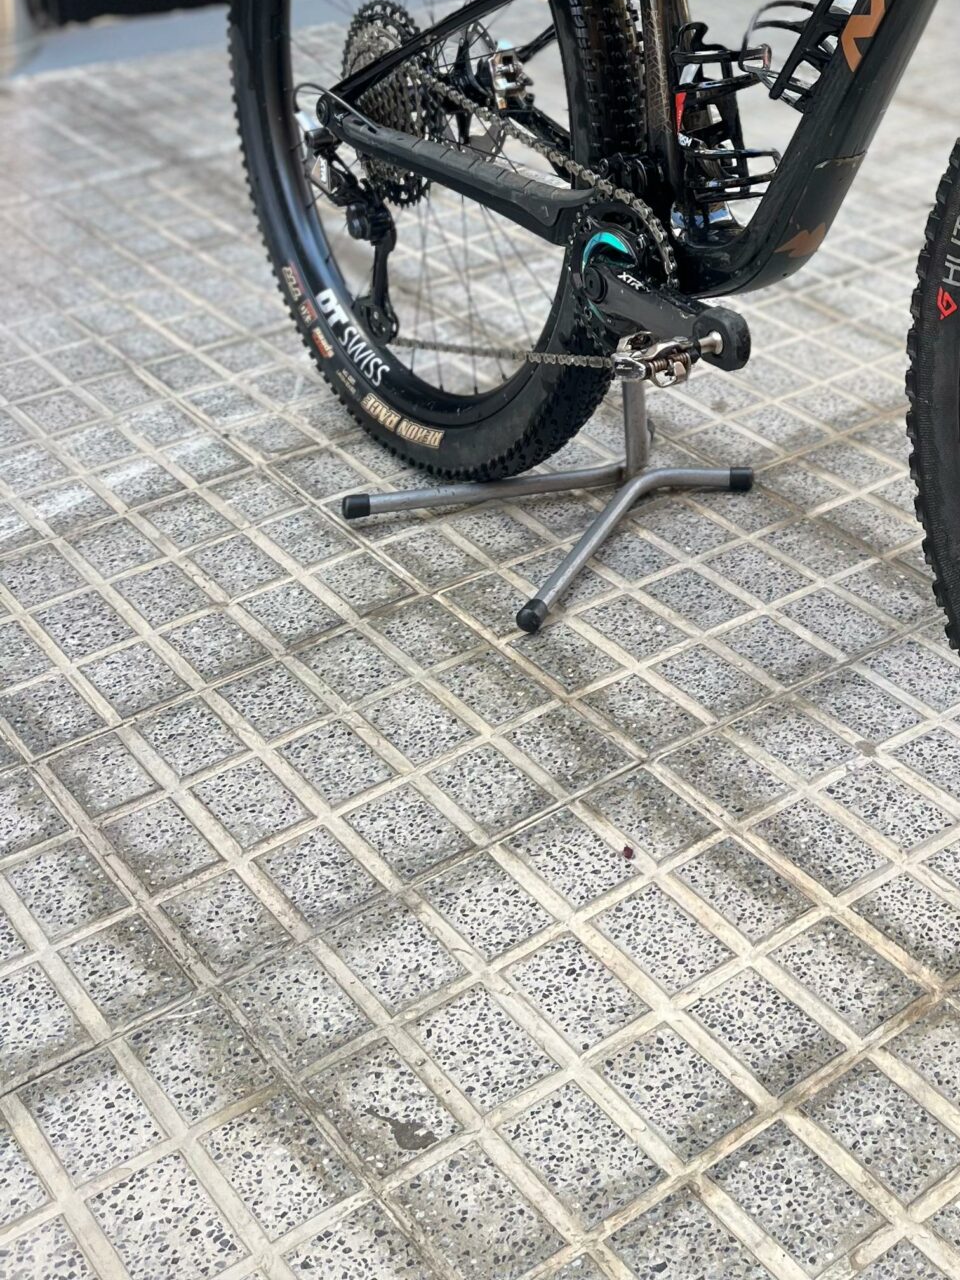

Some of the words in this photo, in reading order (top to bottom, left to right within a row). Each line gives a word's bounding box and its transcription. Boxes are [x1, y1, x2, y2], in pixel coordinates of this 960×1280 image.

[617, 271, 644, 291] XTR
[315, 287, 350, 327] DT
[339, 326, 390, 387] SWISS
[360, 392, 402, 433] RACE
[396, 418, 446, 450] REKON
